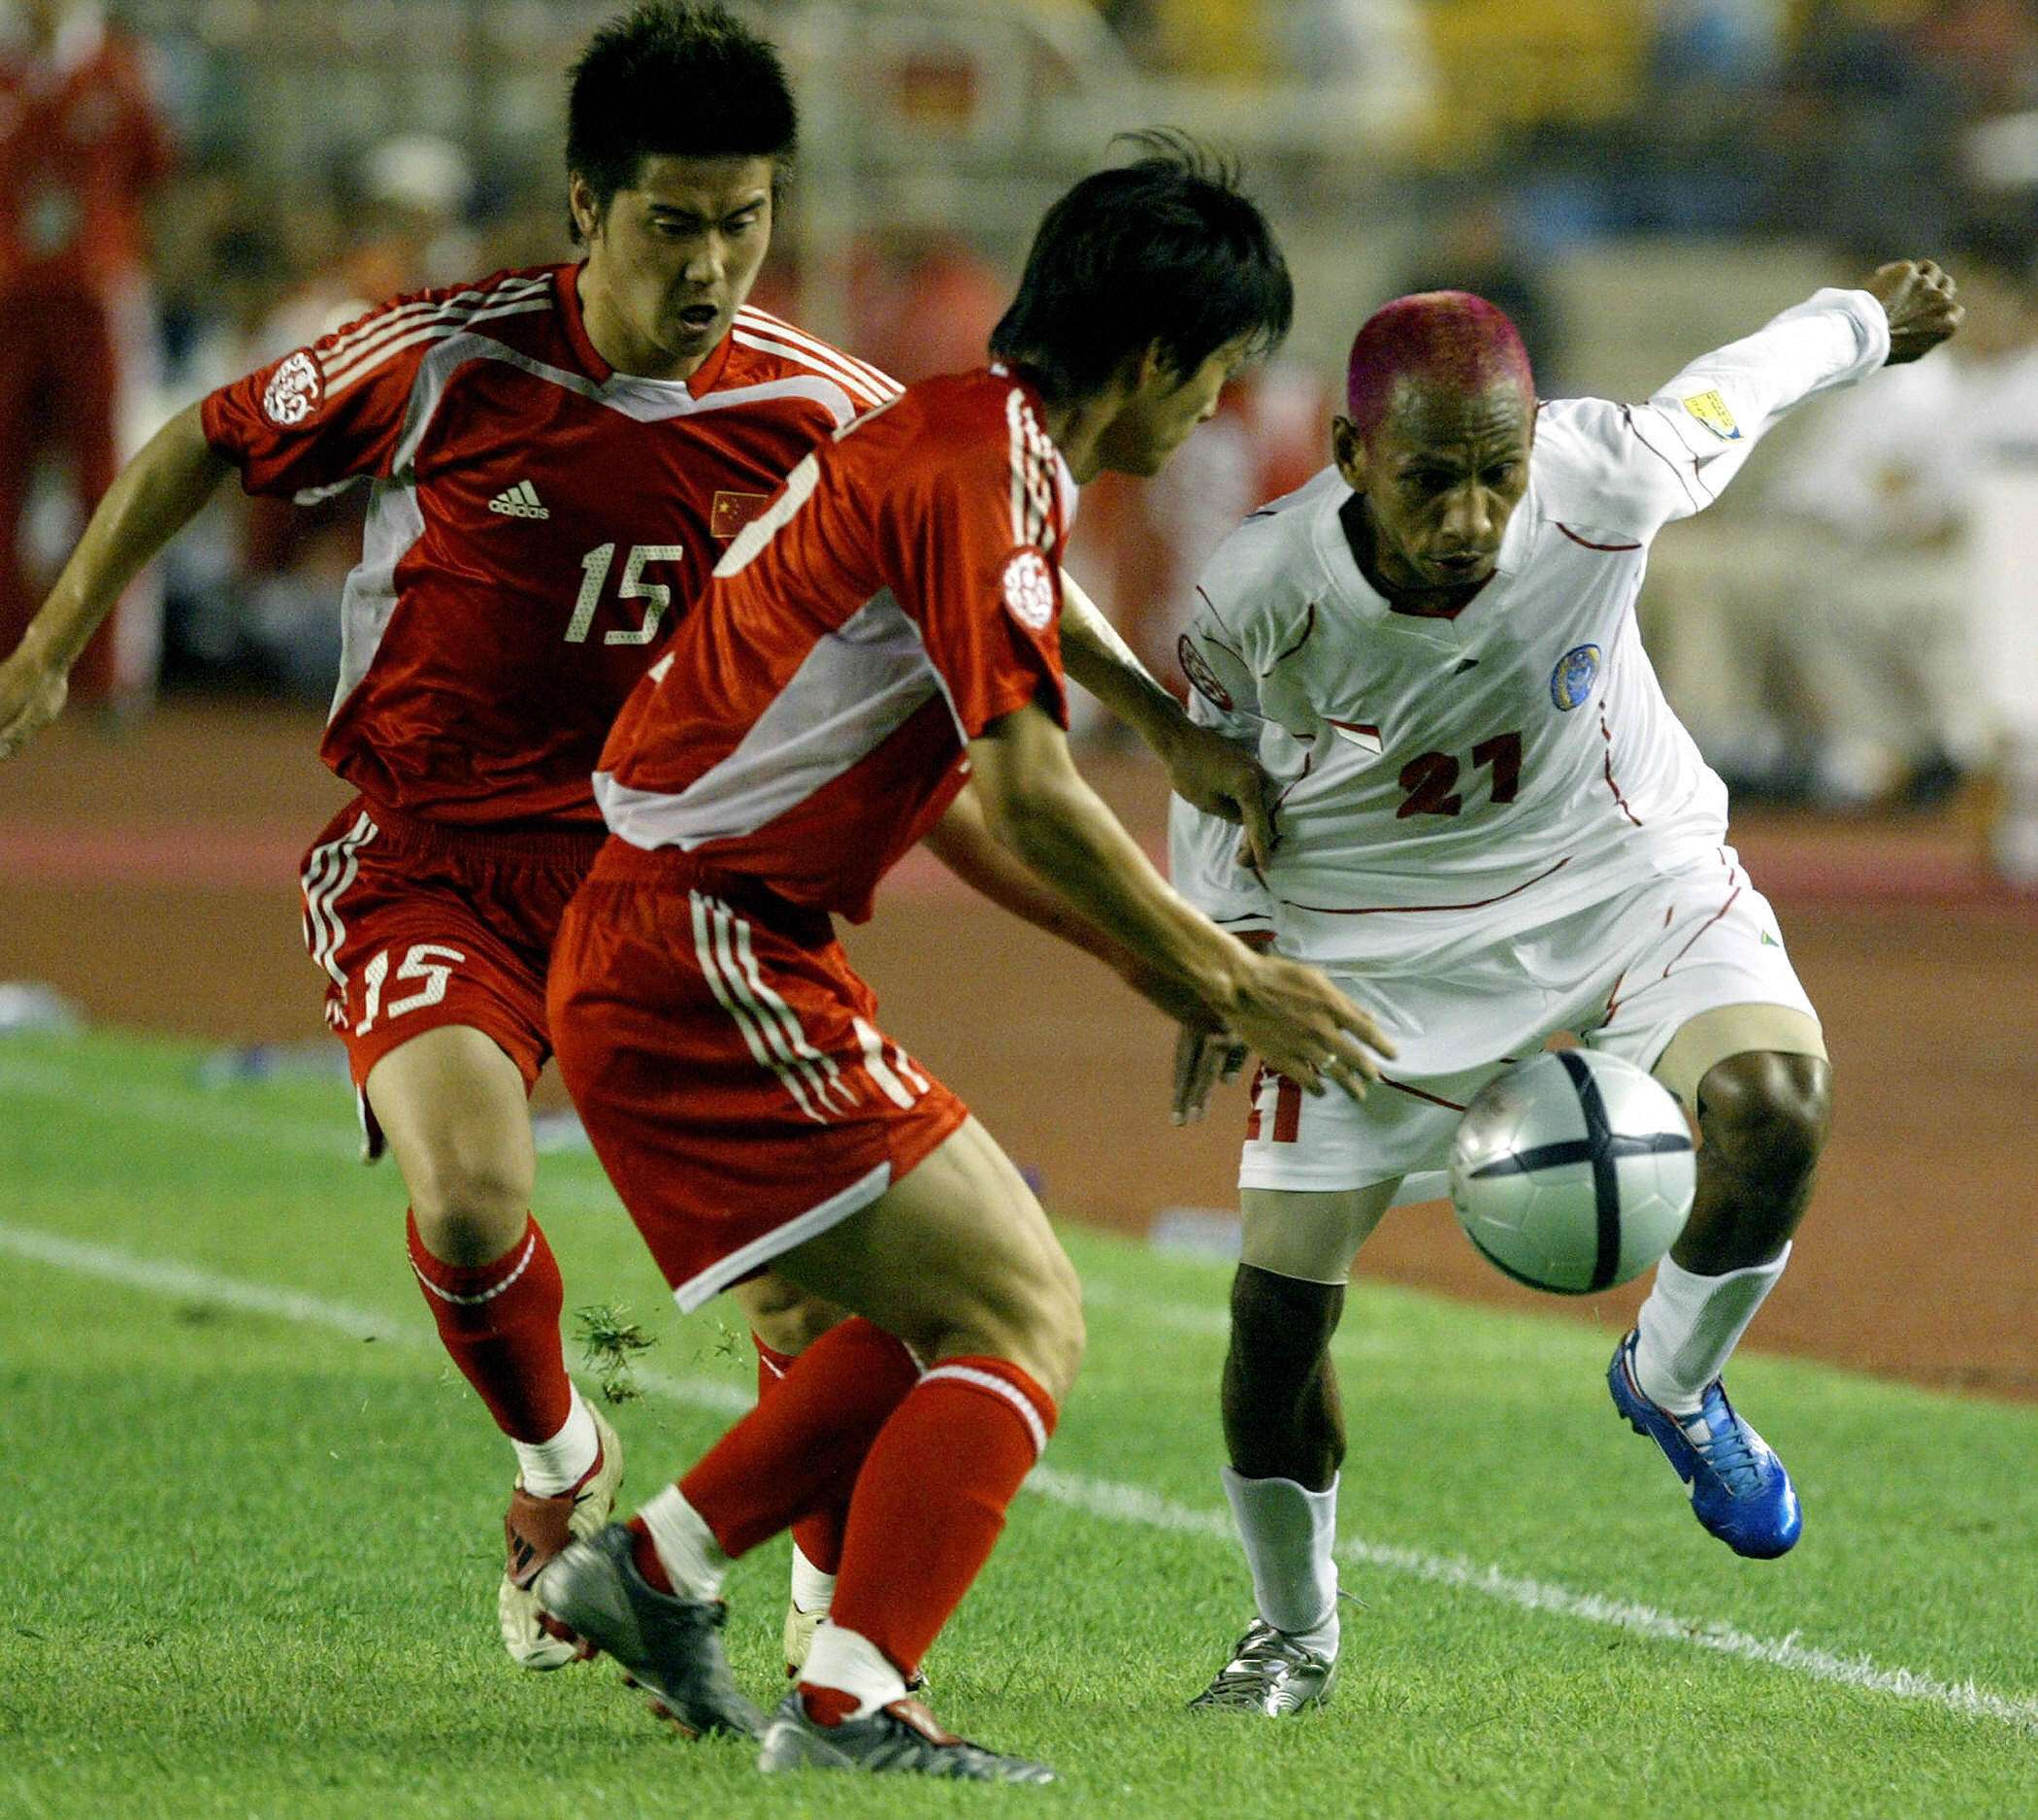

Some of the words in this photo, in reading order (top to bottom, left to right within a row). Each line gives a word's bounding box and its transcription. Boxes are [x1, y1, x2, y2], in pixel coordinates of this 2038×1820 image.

[488, 499, 550, 520] adidas
[563, 542, 683, 645] 15
[1396, 730, 1523, 819] 21
[355, 943, 466, 1038] 15
